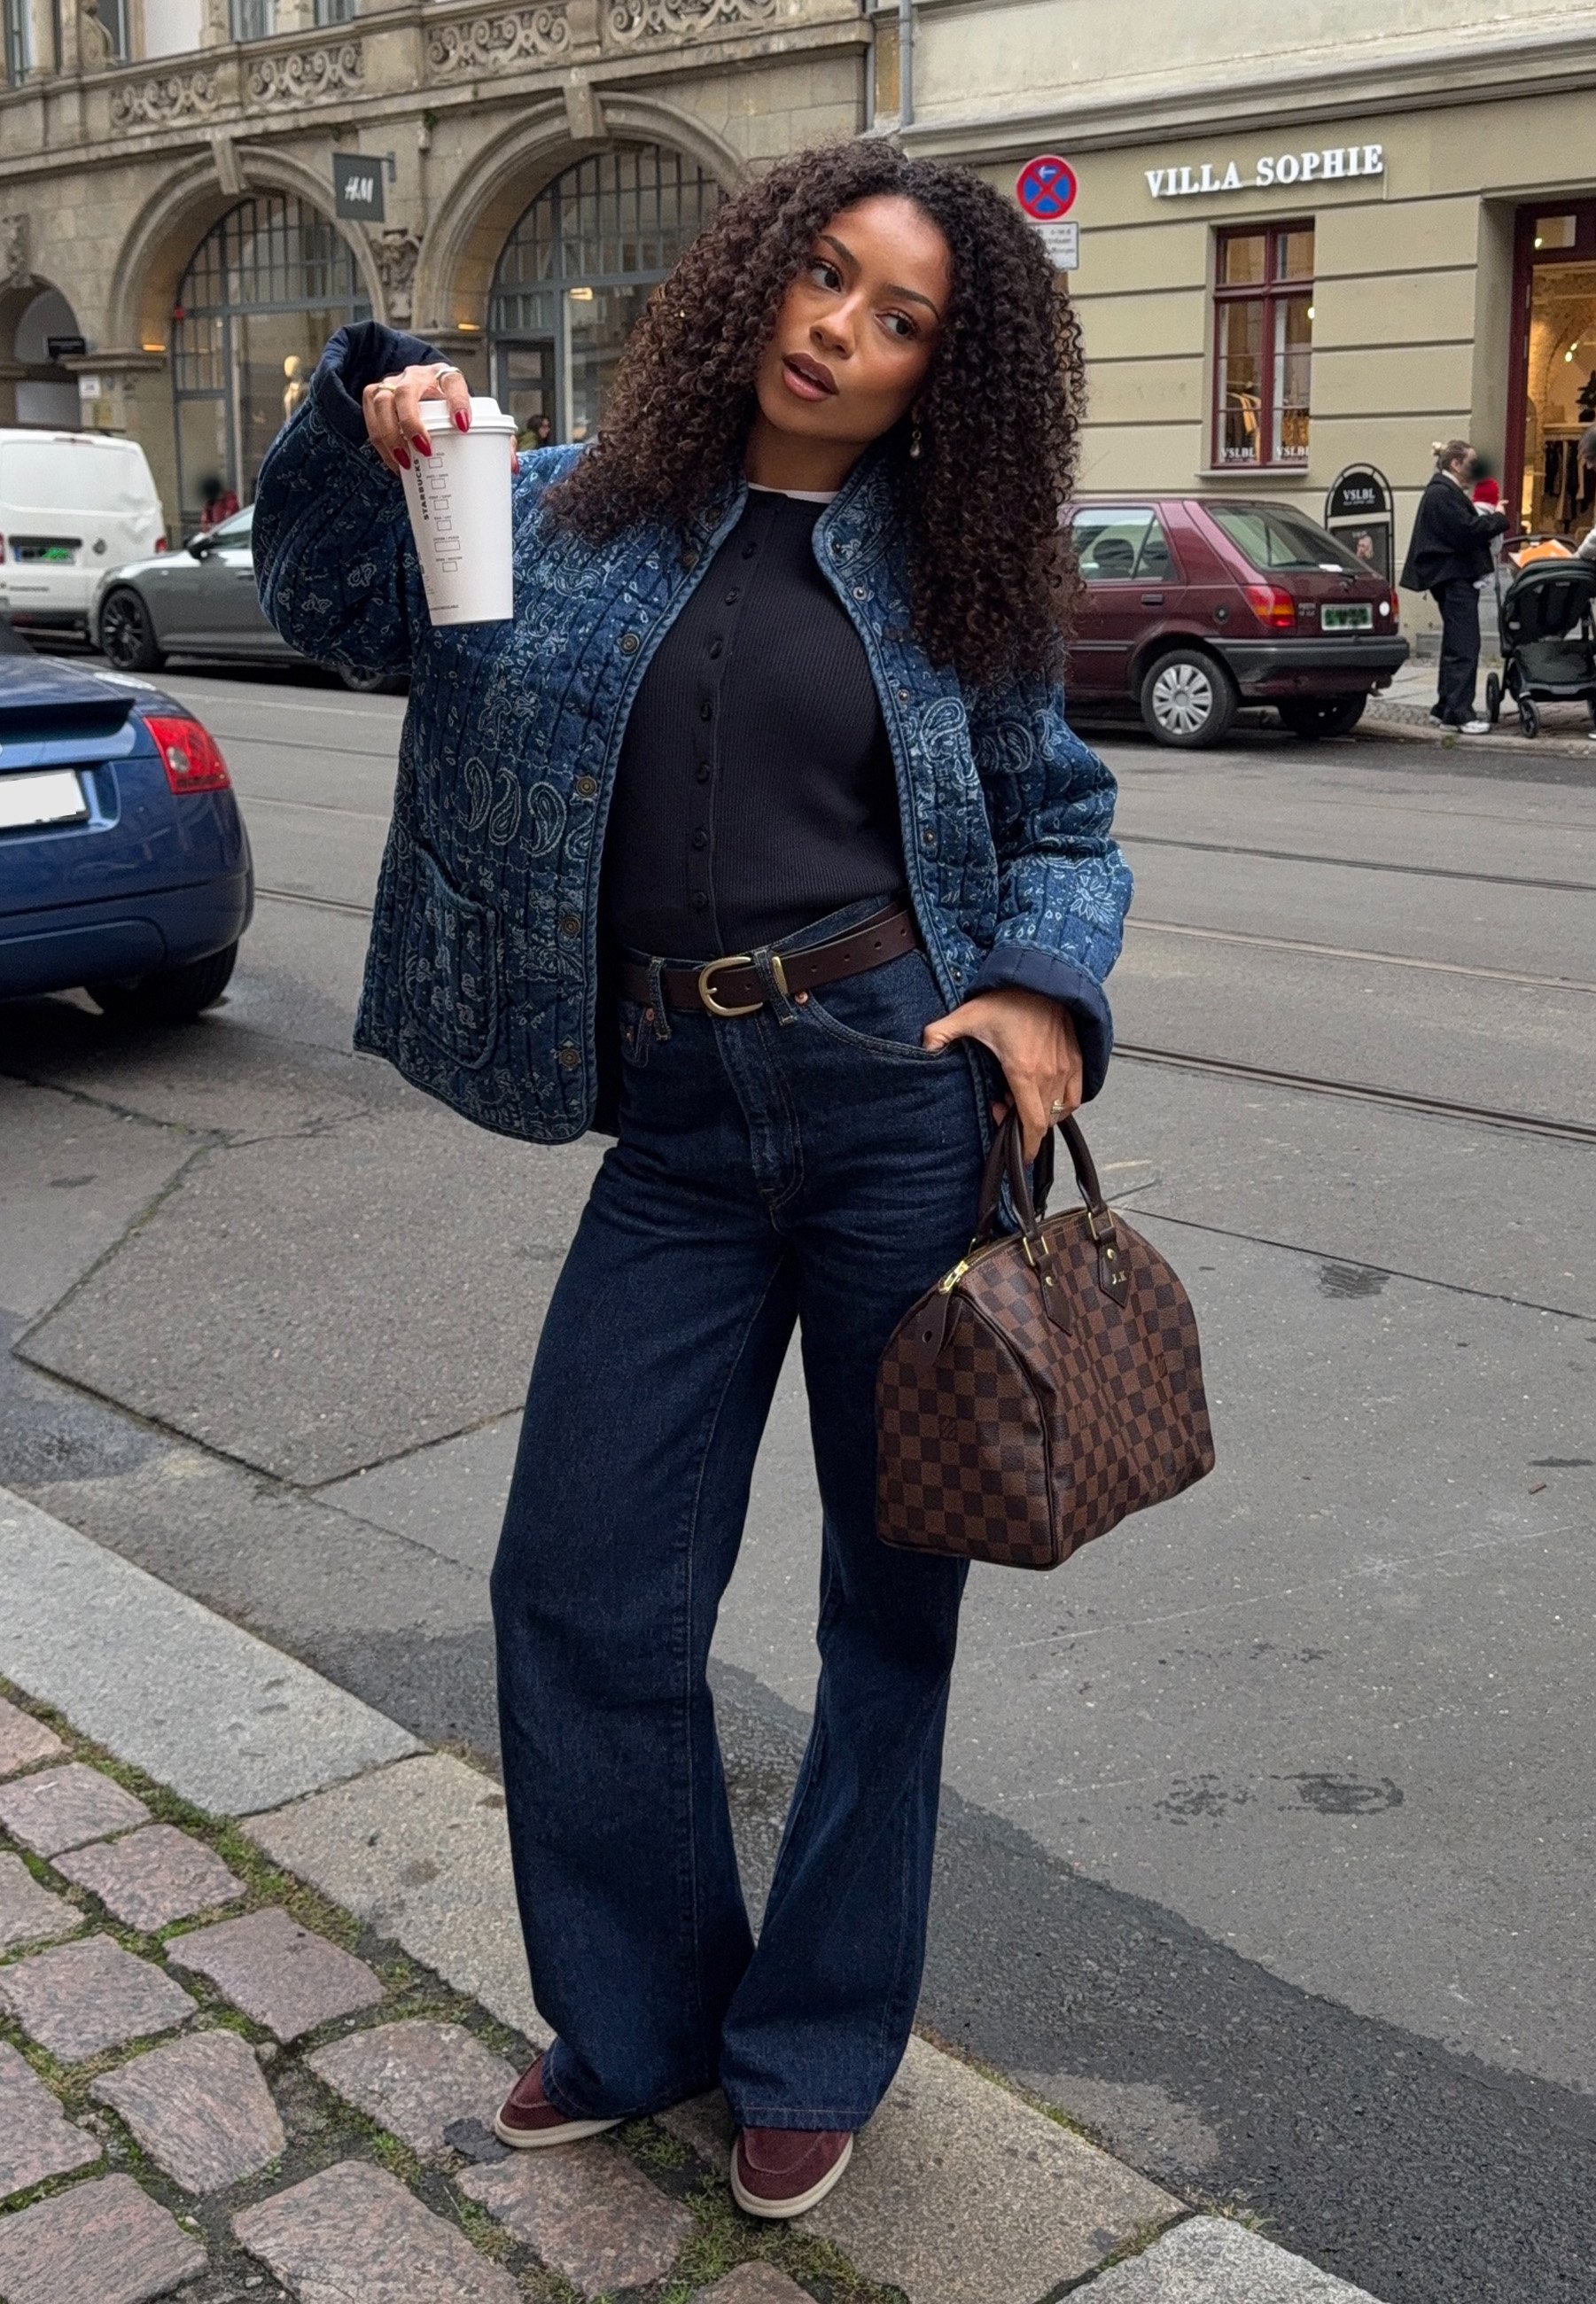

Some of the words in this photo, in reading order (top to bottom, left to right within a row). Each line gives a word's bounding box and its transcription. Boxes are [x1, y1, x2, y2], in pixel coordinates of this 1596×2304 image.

[1145, 160, 1242, 198] VILLA
[1256, 144, 1383, 186] SOPHIE
[414, 458, 429, 520] STARBUCKS
[1343, 487, 1375, 501] VSLBL
